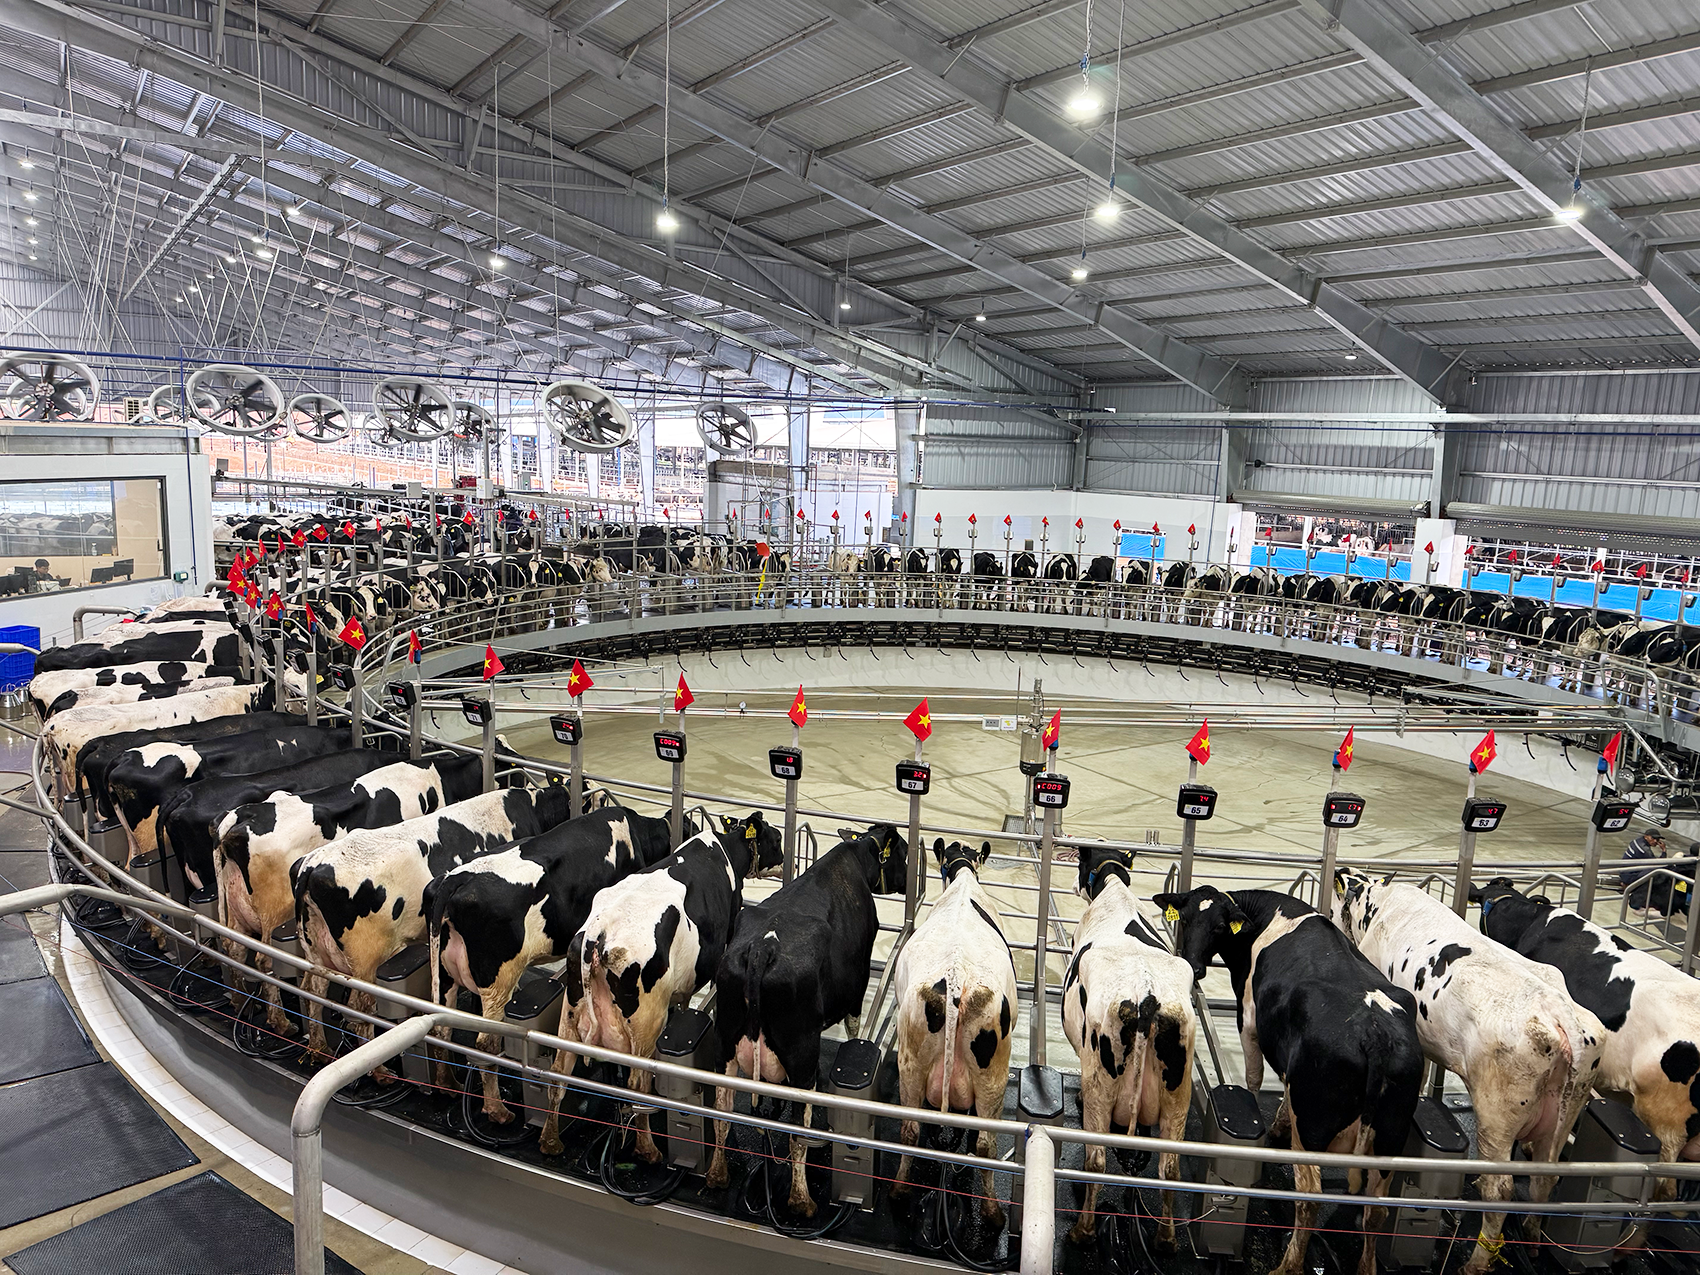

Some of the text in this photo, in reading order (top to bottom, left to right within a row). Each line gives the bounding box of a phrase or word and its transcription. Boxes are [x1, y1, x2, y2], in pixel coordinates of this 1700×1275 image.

[665, 749, 674, 757] 69
[1046, 795, 1056, 803] 66
[1191, 806, 1202, 814] 65
[1479, 819, 1490, 827] 63
